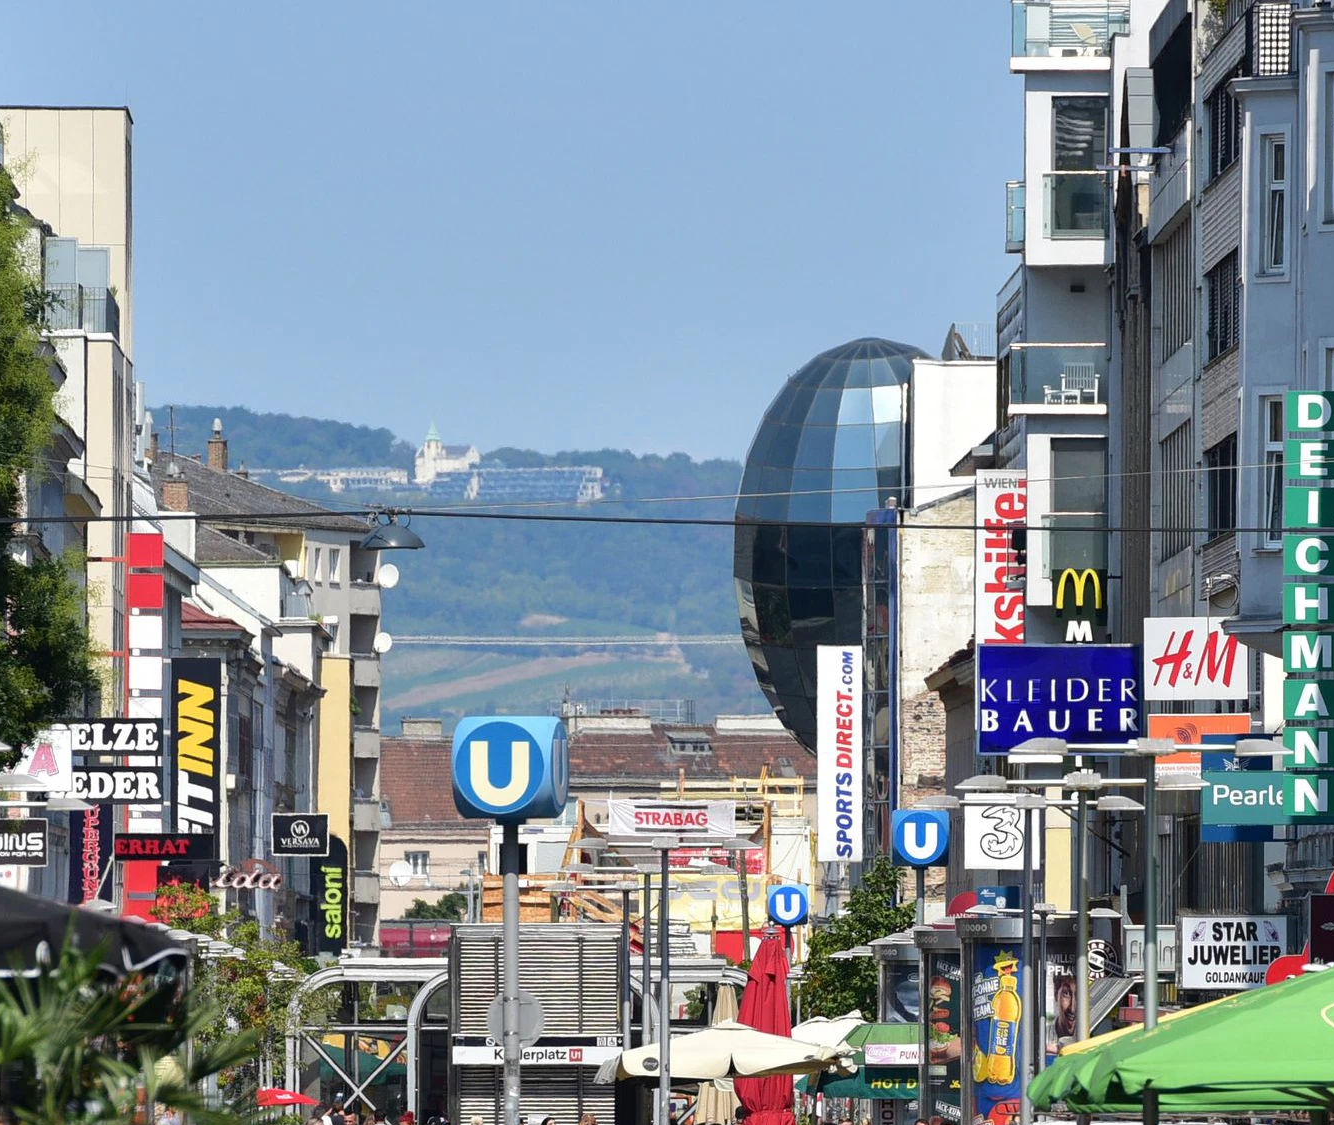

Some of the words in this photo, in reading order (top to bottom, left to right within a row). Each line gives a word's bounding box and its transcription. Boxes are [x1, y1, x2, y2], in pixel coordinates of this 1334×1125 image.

[984, 477, 1017, 489] WIEN
[1290, 393, 1333, 813] DEICHMANN
[1152, 630, 1238, 688] H&M
[981, 678, 1138, 704] KLEIDER
[981, 708, 1139, 732] BAUER
[67, 722, 159, 751] ELZE
[470, 740, 529, 807] U
[67, 771, 161, 799] EDER
[634, 811, 708, 827] STRABAG
[115, 839, 190, 855] ERHAT
[280, 837, 320, 846] VERSAVA
[903, 822, 938, 860] U
[775, 893, 801, 921] U
[1212, 921, 1258, 942] STAR
[1187, 945, 1281, 966] JUWELIER
[1205, 971, 1265, 984] GOLDANKAUF
[494, 1049, 567, 1062] Klerplatz
[871, 1078, 900, 1089] HOT
